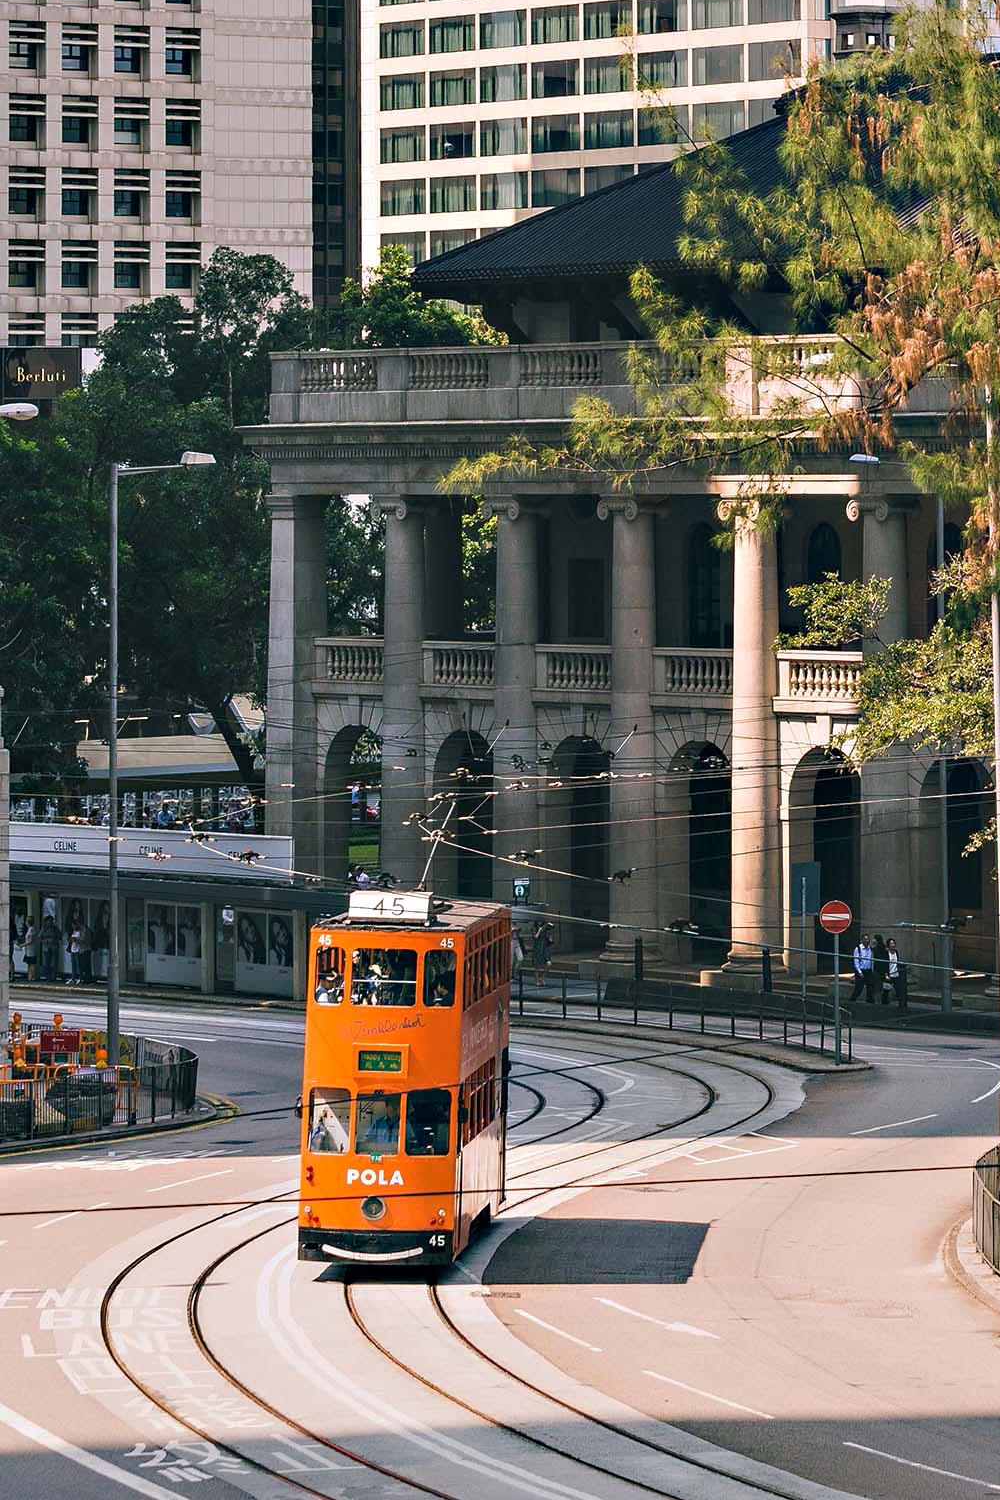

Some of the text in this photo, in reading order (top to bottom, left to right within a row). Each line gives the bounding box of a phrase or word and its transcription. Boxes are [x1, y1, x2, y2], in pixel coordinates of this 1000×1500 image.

[17, 366, 66, 382] Berluti
[53, 840, 77, 851] CELINE
[374, 897, 405, 916] 45
[318, 934, 332, 946] 45
[440, 937, 454, 948] 45
[346, 1168, 404, 1186] POLA
[428, 1235, 446, 1247] 45
[39, 1308, 185, 1330] BUS
[20, 1331, 195, 1358] LANE
